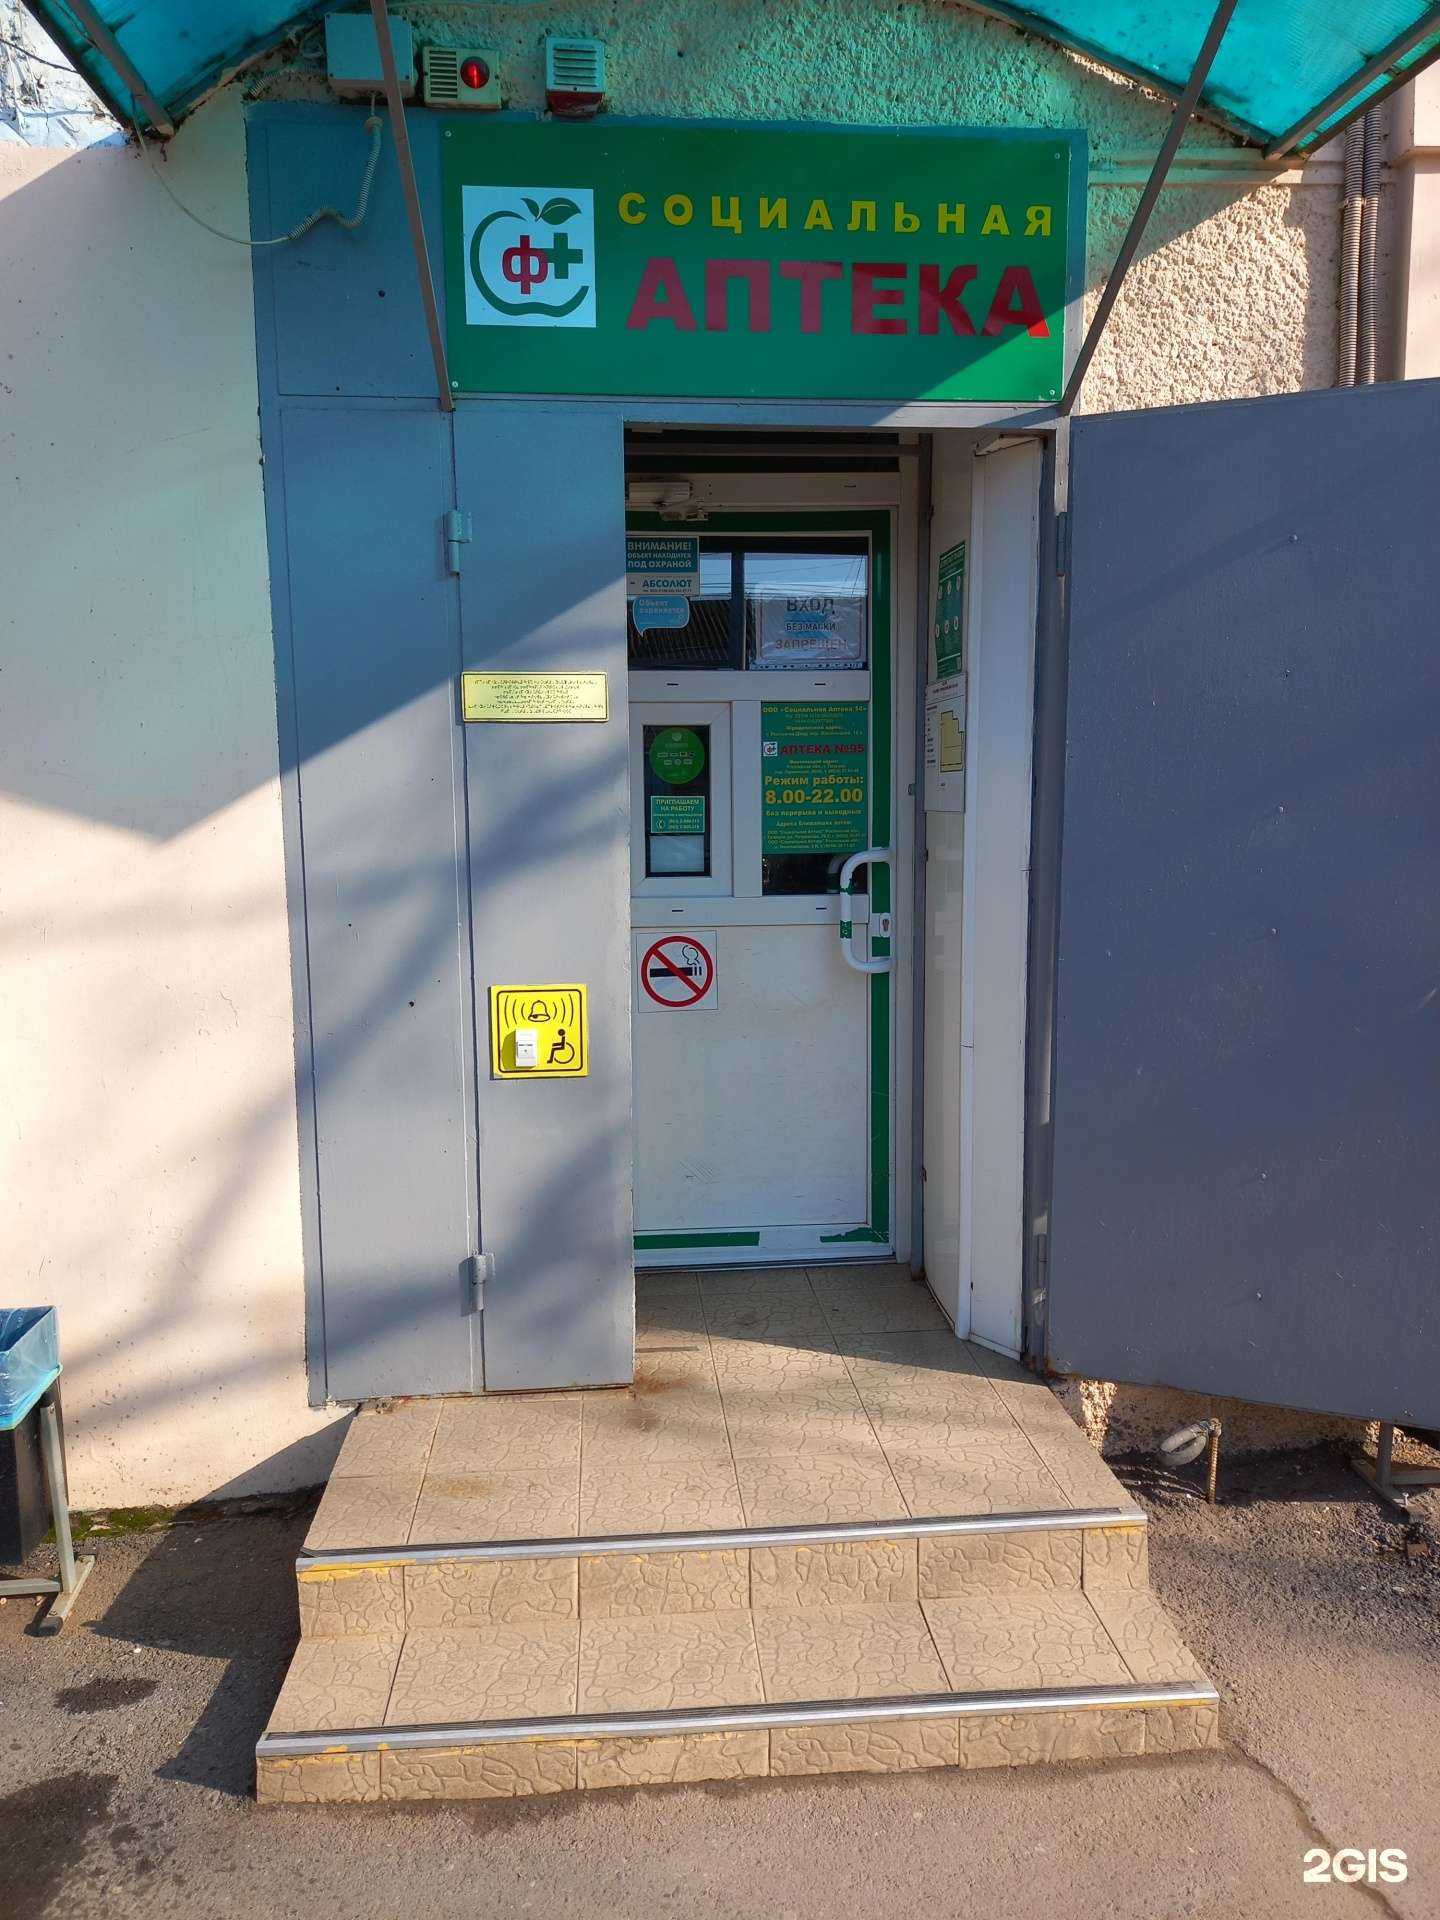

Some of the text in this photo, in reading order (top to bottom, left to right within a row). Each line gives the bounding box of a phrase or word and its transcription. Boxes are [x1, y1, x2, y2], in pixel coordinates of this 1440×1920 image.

[618, 192, 1053, 236] СОЦИАЛЬНАЯ
[625, 256, 1051, 337] АПТЕКА
[628, 560, 691, 568] ПОД ОХРАНОЙ
[642, 579, 692, 588] АБСОЛЮТ
[786, 598, 836, 614] ВХОД
[803, 622, 837, 631] МАКИ
[765, 774, 864, 787] Режим работы:
[765, 788, 863, 804] 8.00-22.00
